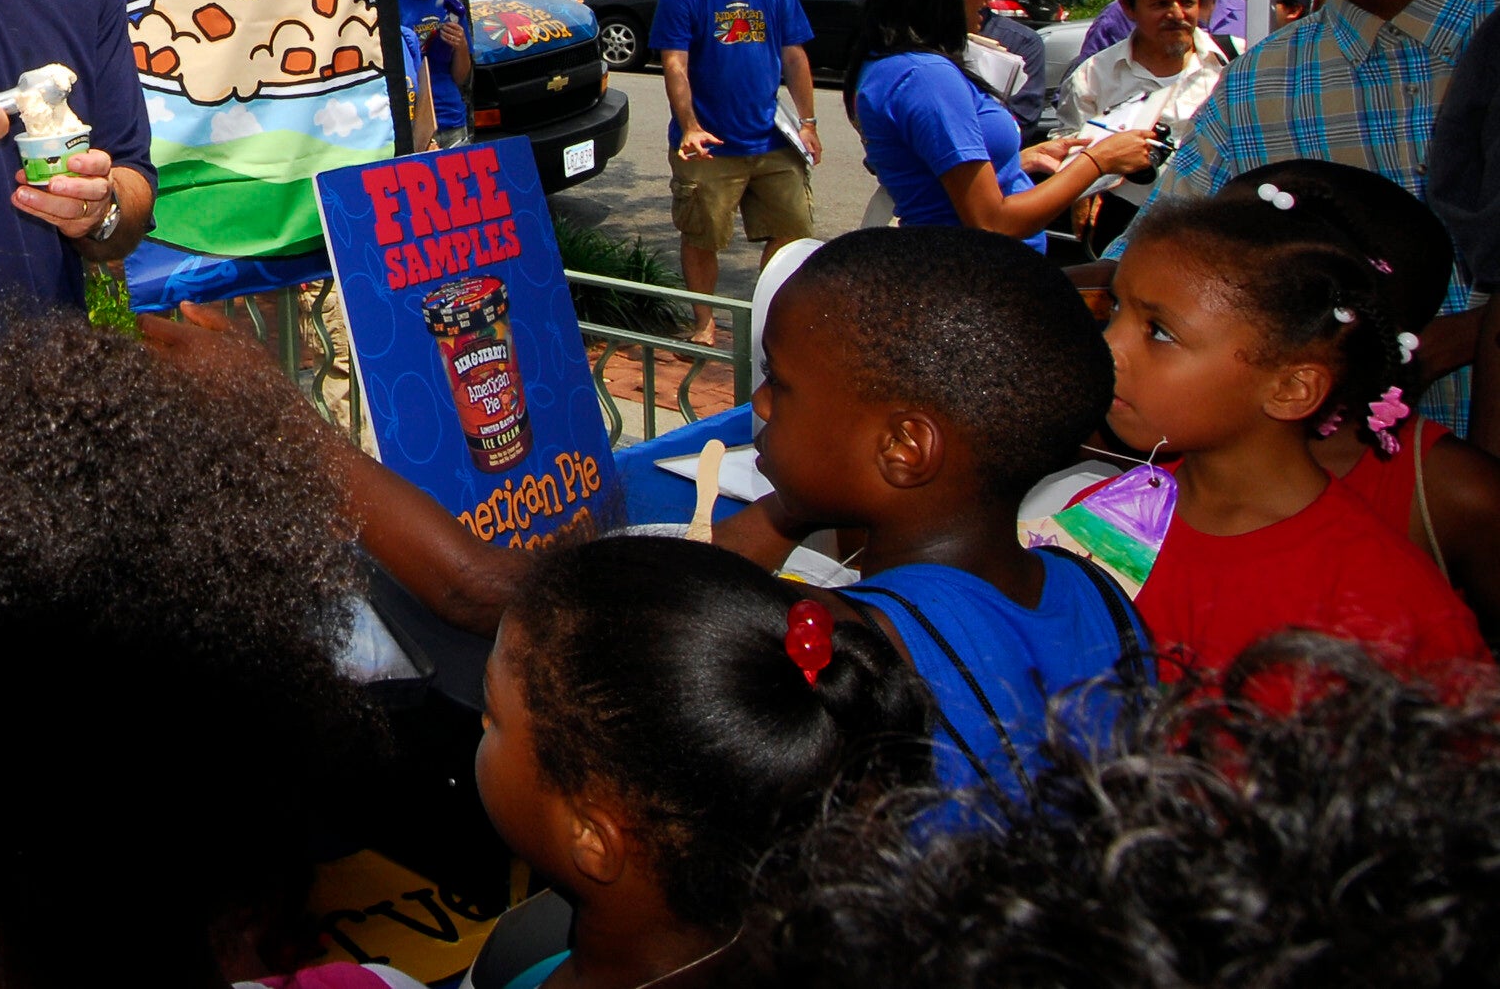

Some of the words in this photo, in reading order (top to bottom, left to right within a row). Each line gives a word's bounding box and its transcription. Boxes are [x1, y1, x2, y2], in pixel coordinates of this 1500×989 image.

[714, 8, 765, 23] American
[516, 19, 573, 44] TOUR
[735, 30, 766, 43] TOUR
[361, 146, 512, 247] FREE
[384, 219, 521, 291] SAMPLES
[467, 371, 511, 404] American
[482, 396, 502, 415] Pie
[555, 450, 601, 503] Pie
